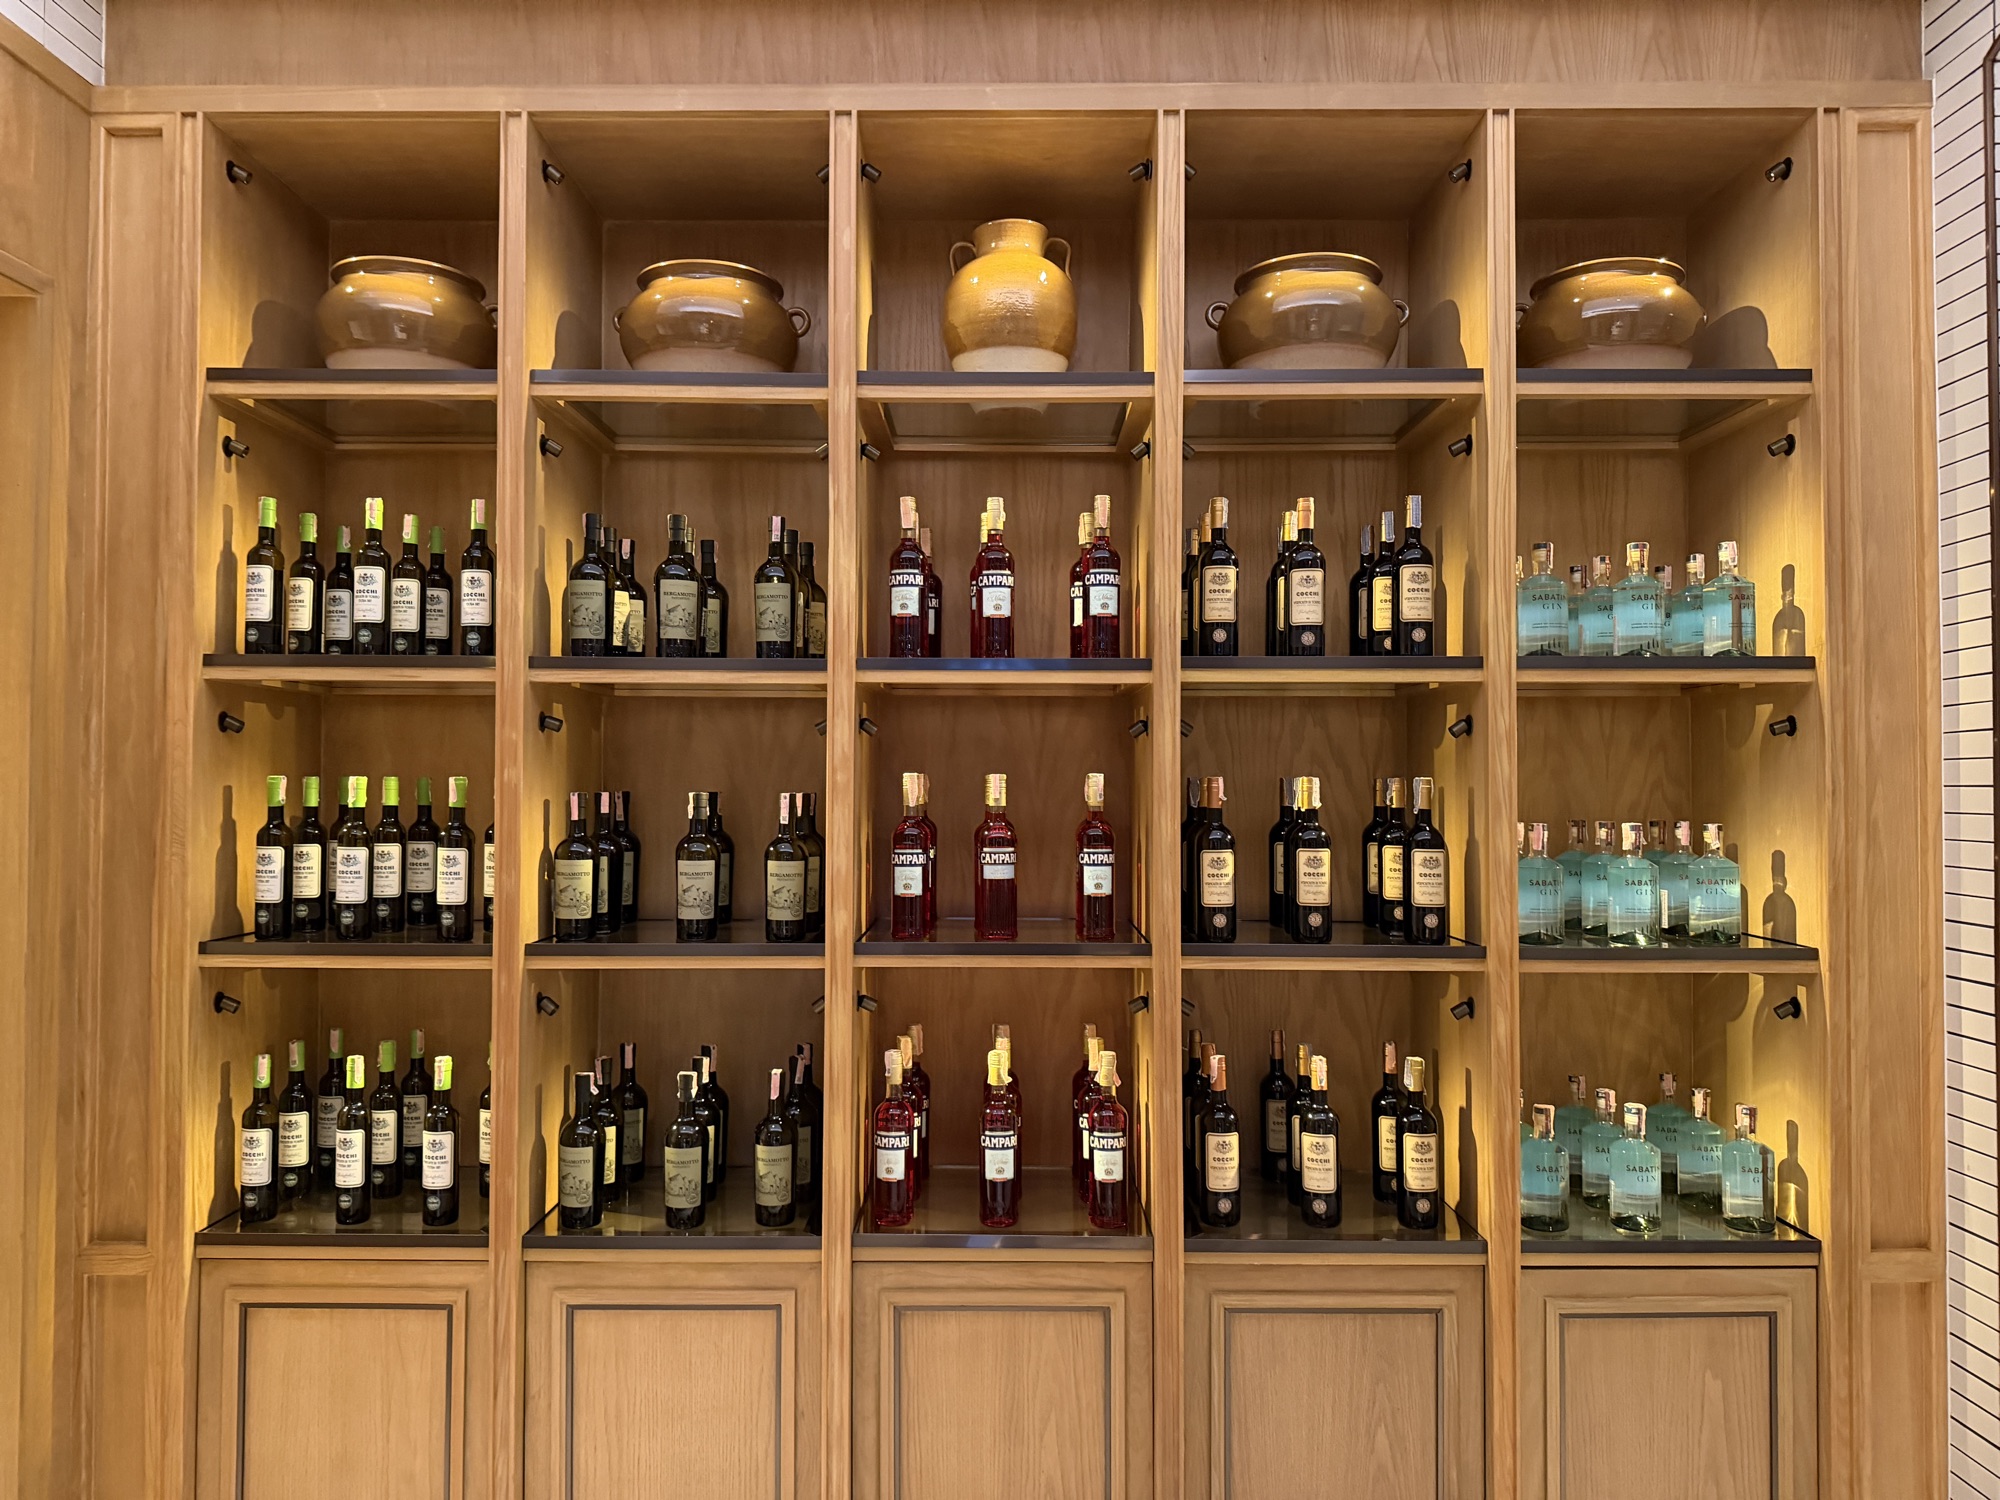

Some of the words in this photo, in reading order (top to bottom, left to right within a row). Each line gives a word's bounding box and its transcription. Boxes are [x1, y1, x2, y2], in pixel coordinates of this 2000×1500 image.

[889, 574, 924, 586] CAMPARI
[978, 575, 1014, 587] CAMPARI
[1084, 574, 1121, 585] CAMPAR
[891, 853, 927, 865] CAMPARI
[980, 853, 1017, 864] CAMPARI
[874, 1134, 910, 1148] CAMPARI
[980, 1134, 1017, 1148] CAMPARI
